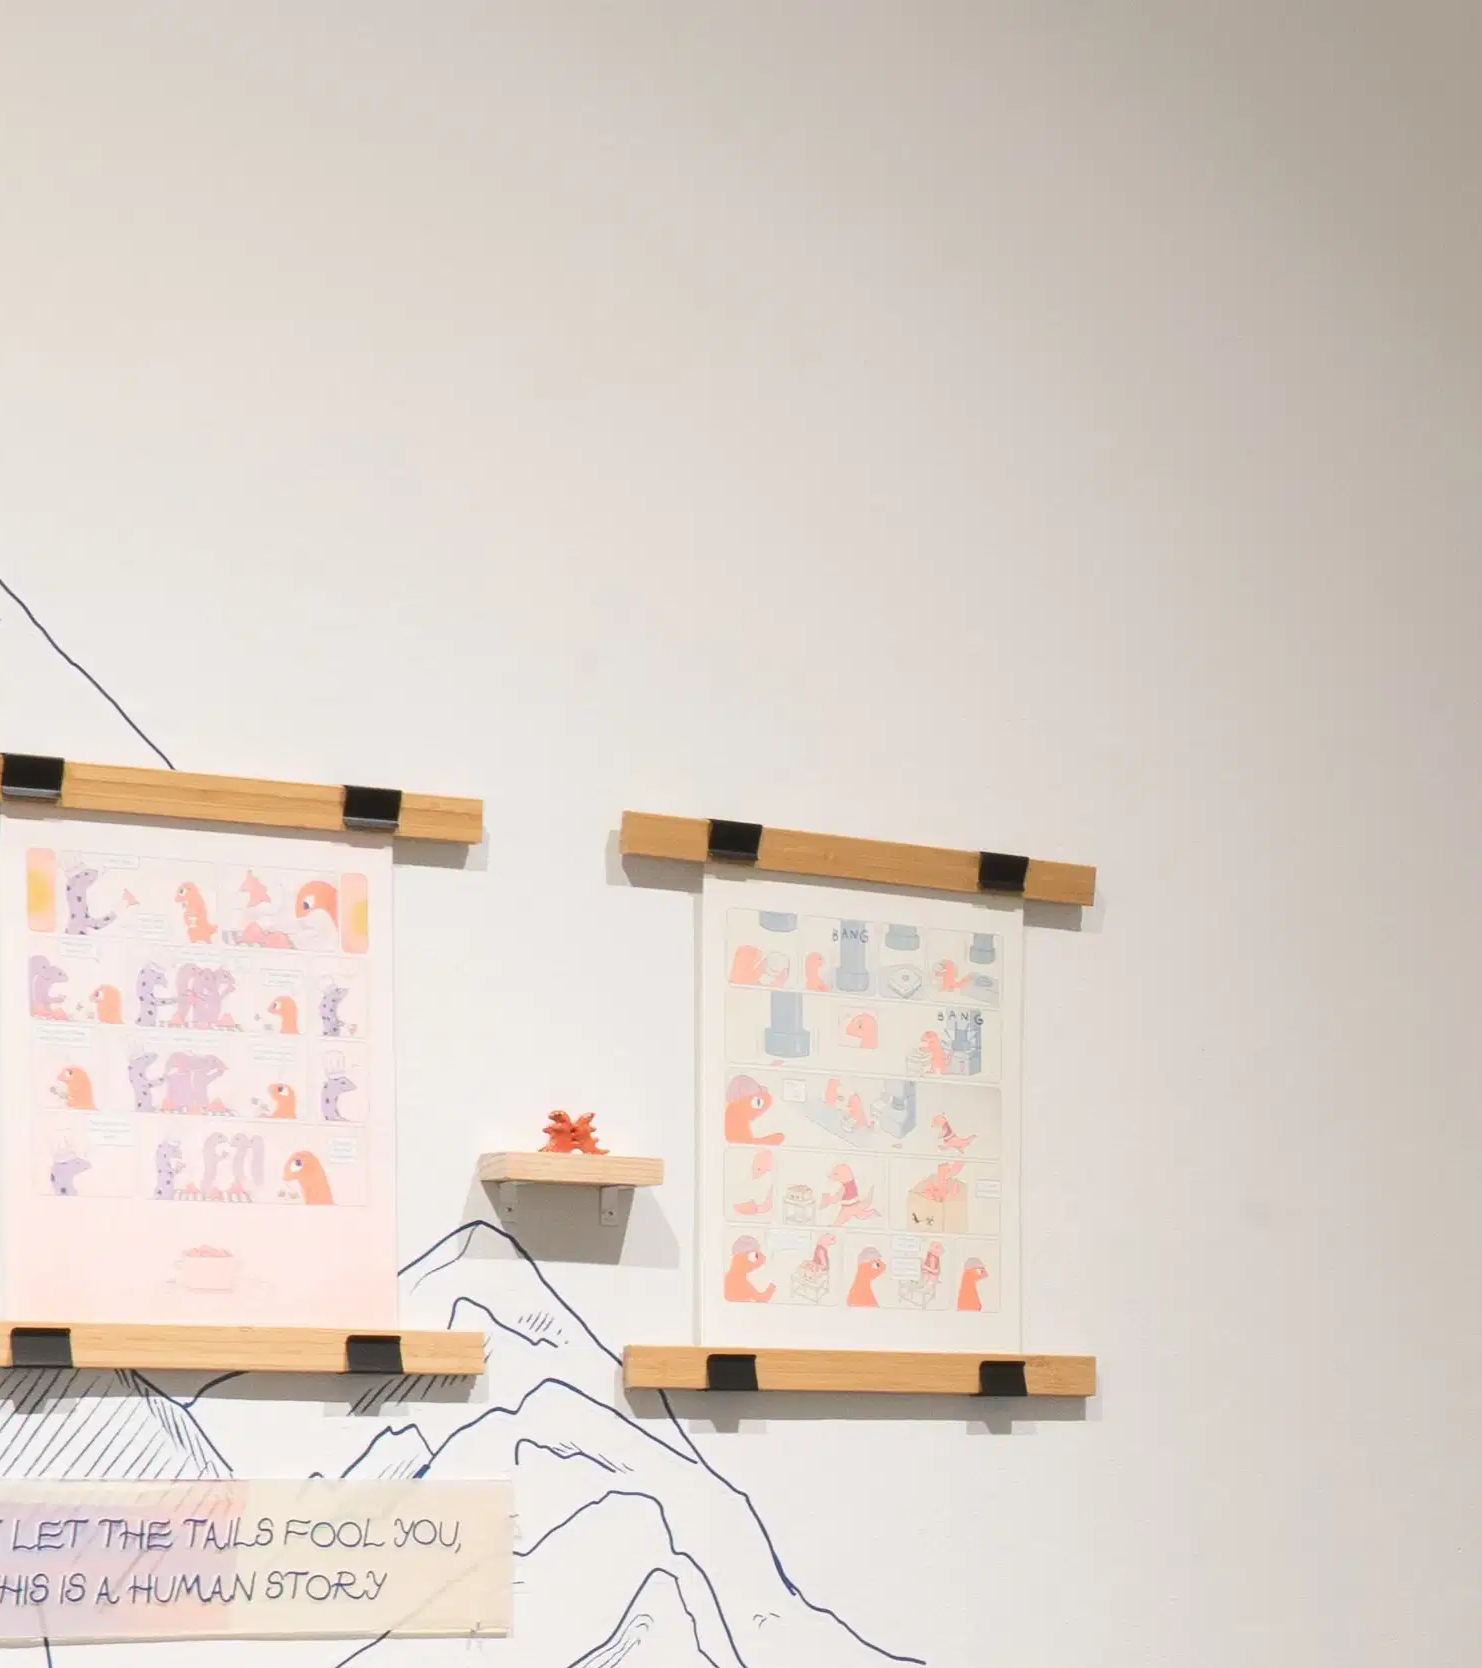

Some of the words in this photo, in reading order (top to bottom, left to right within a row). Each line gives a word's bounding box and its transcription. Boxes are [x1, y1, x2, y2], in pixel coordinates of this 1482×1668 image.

[832, 927, 869, 943] BANG
[937, 1010, 984, 1025] BANG
[12, 1518, 90, 1551] LET
[97, 1518, 174, 1551] THE
[182, 1517, 274, 1550] TAILS
[283, 1517, 386, 1548] FOOL
[393, 1517, 462, 1554] YOU,
[59, 1572, 87, 1605] IS
[94, 1575, 120, 1606] A
[127, 1570, 257, 1605] HUMAN
[265, 1570, 389, 1601] STORY
